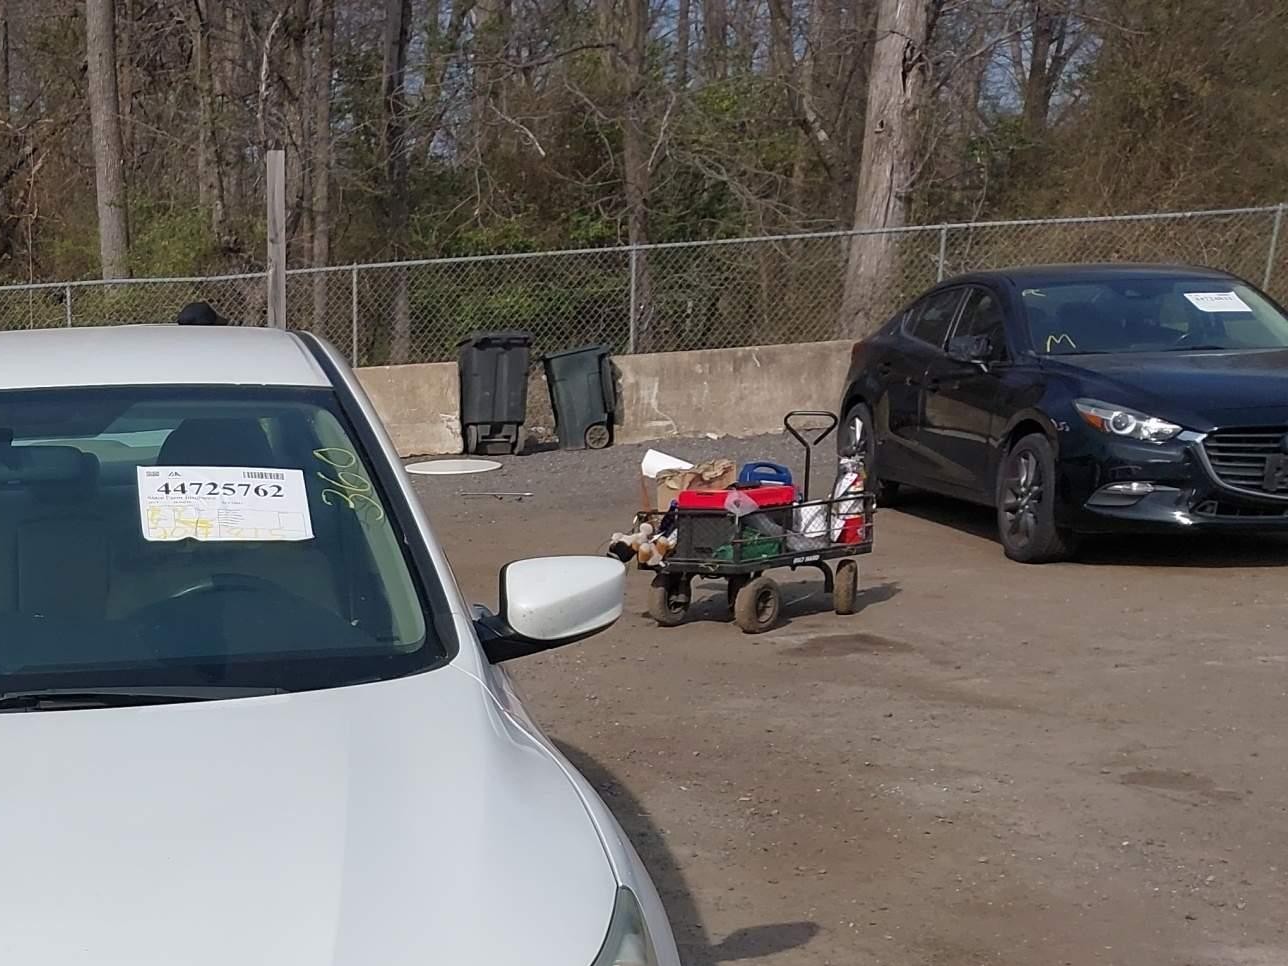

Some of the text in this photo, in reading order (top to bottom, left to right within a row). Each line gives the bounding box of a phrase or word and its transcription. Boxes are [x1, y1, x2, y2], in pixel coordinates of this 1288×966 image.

[1046, 333, 1076, 353] M
[156, 481, 285, 498] 44725762
[312, 447, 385, 521] 360
